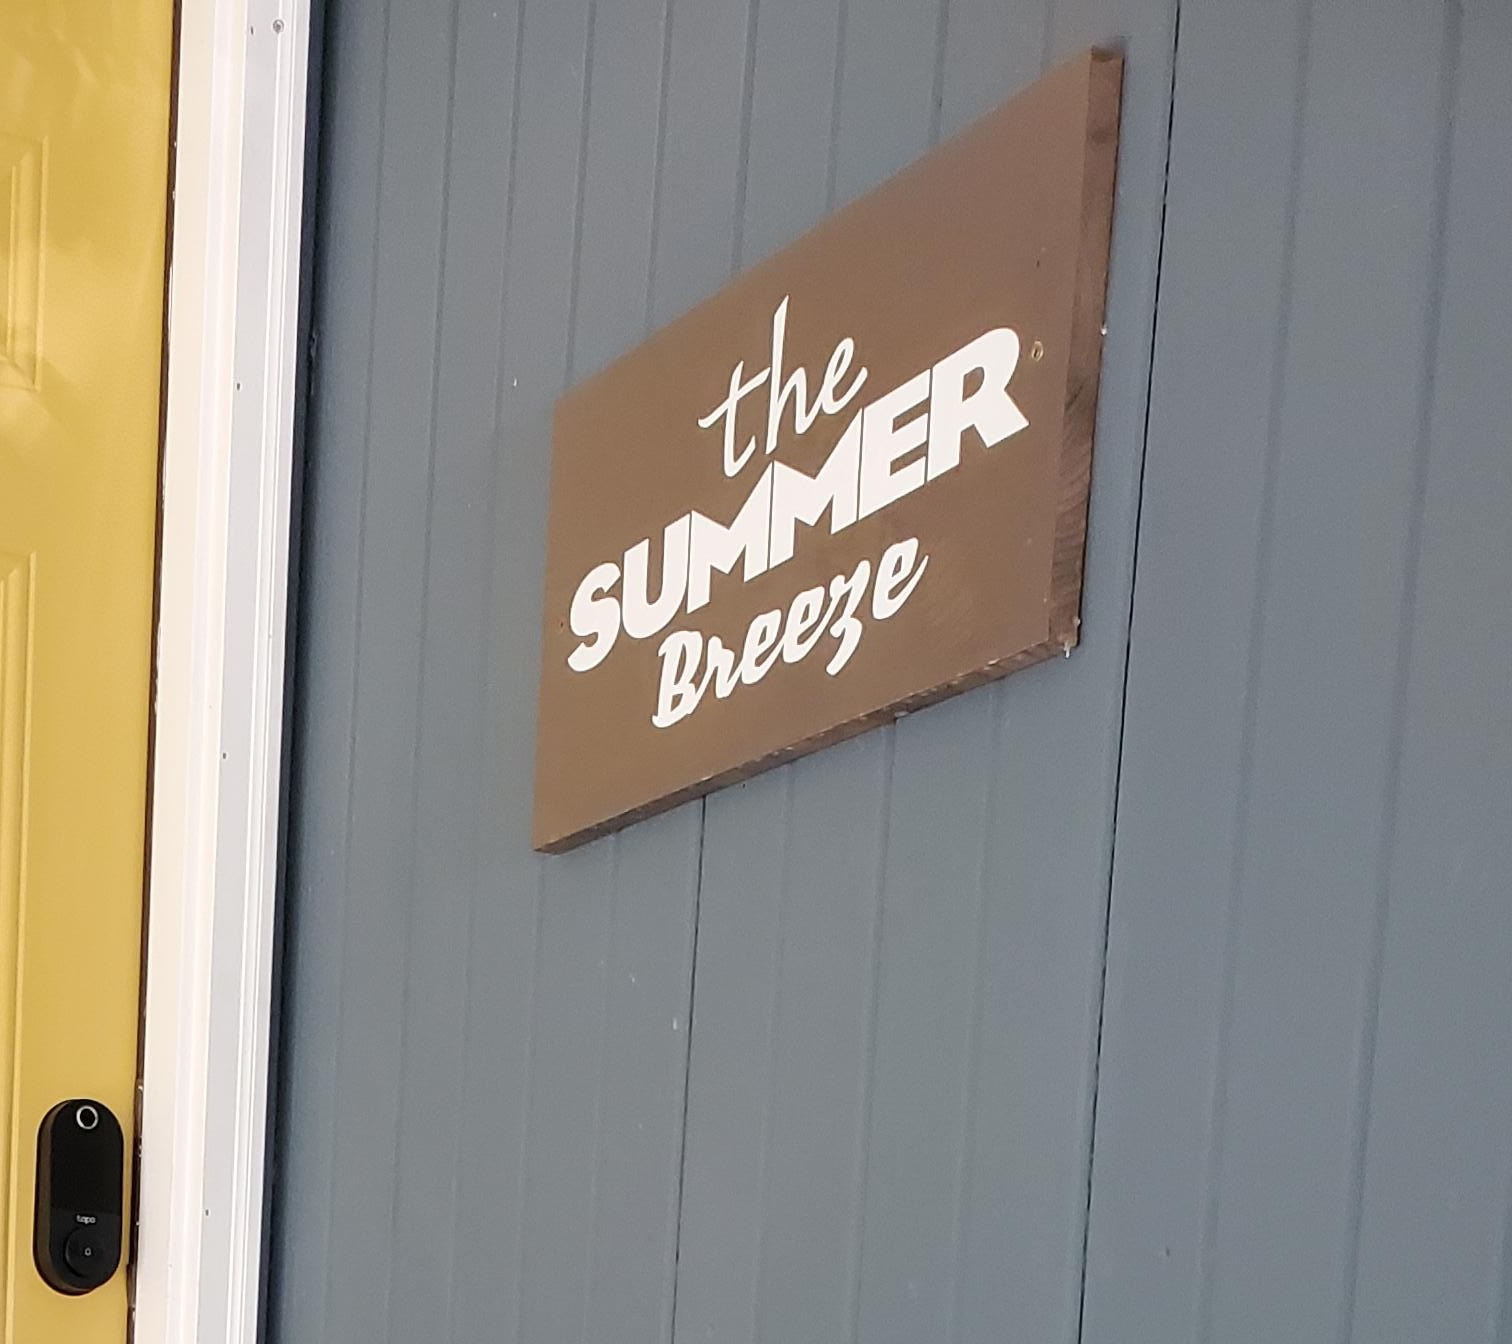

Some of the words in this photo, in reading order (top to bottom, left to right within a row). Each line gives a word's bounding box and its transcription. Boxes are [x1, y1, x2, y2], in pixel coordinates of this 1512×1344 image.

[698, 295, 868, 477] the
[567, 327, 1030, 673] SUMMER
[651, 537, 930, 729] Breeze
